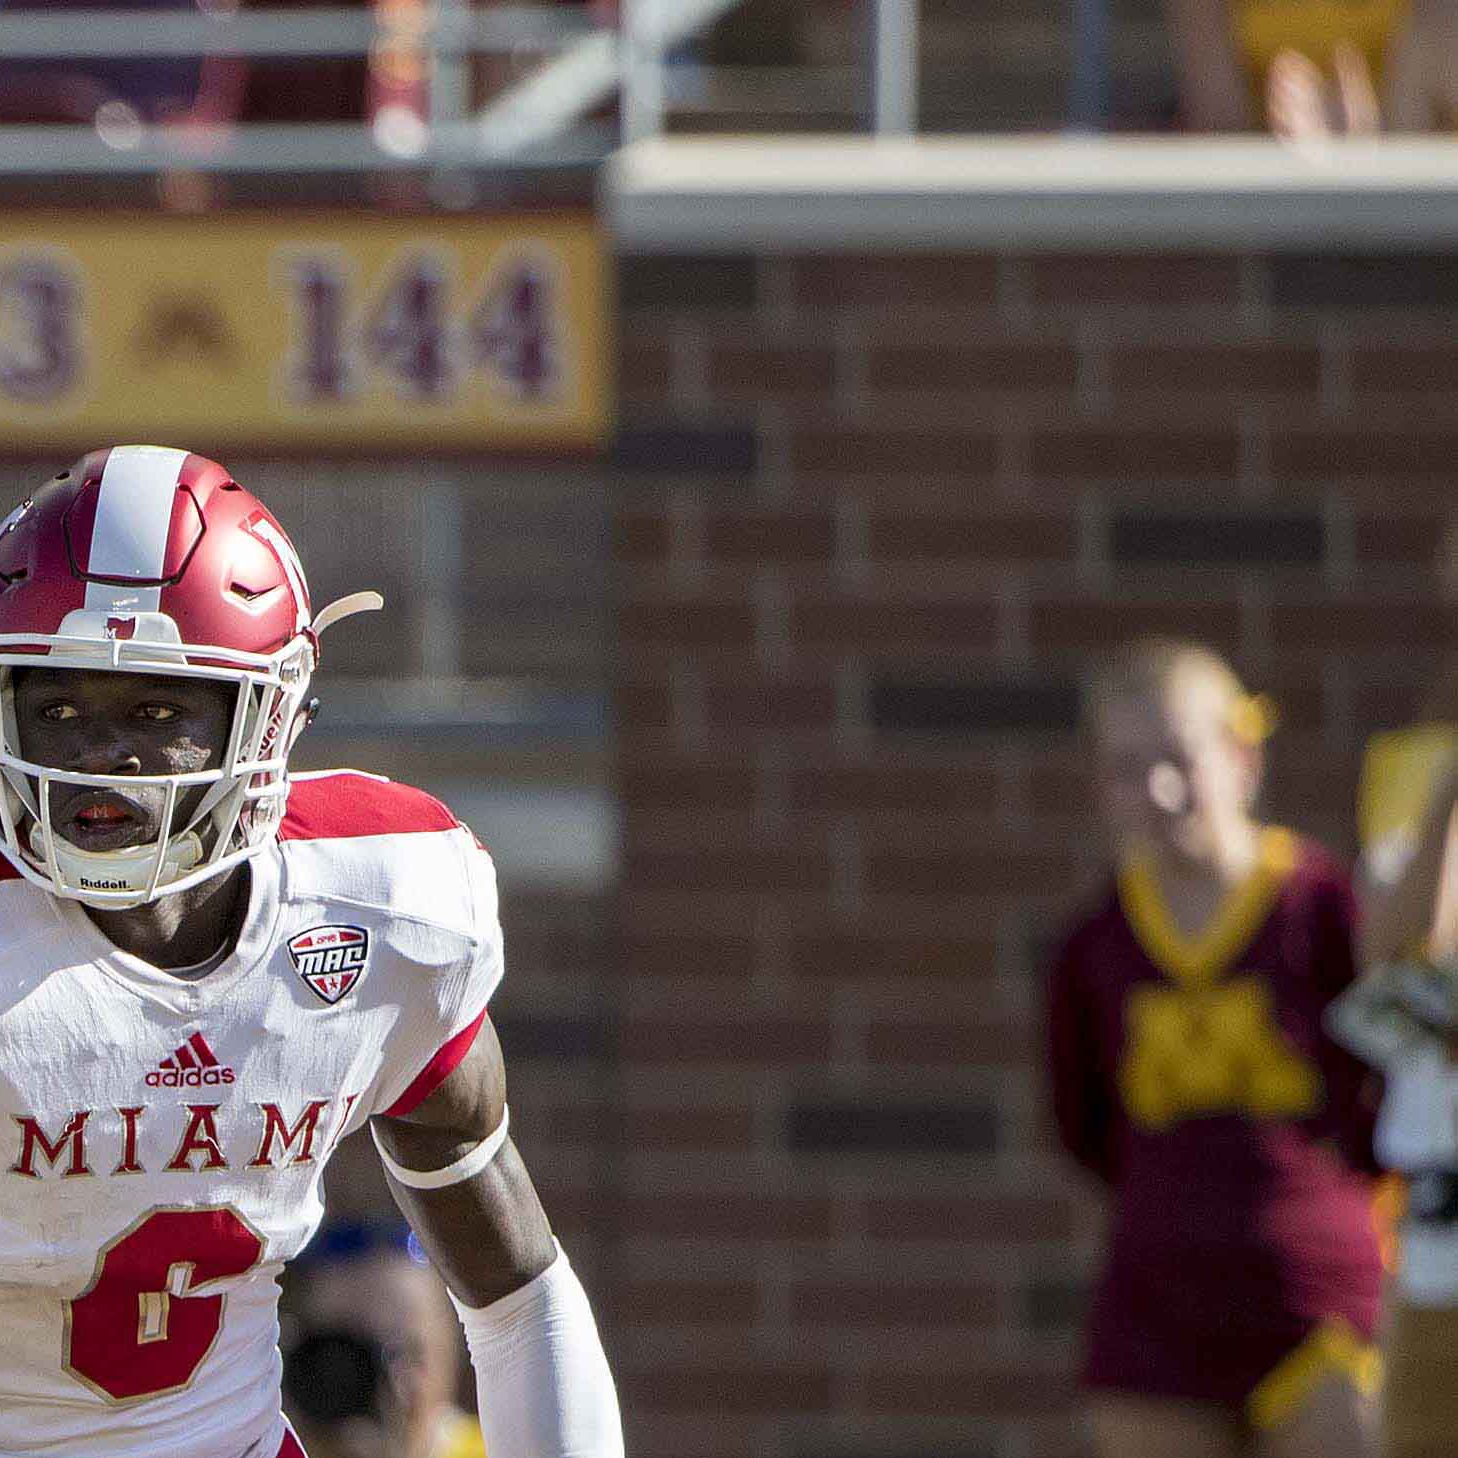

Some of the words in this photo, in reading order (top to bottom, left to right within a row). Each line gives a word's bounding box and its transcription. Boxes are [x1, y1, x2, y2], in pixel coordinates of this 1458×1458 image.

[272, 245, 582, 418] 144
[79, 877, 127, 889] Riddell
[296, 946, 366, 975] MAC
[145, 1066, 236, 1088] adidas
[60, 1202, 270, 1407] 6
